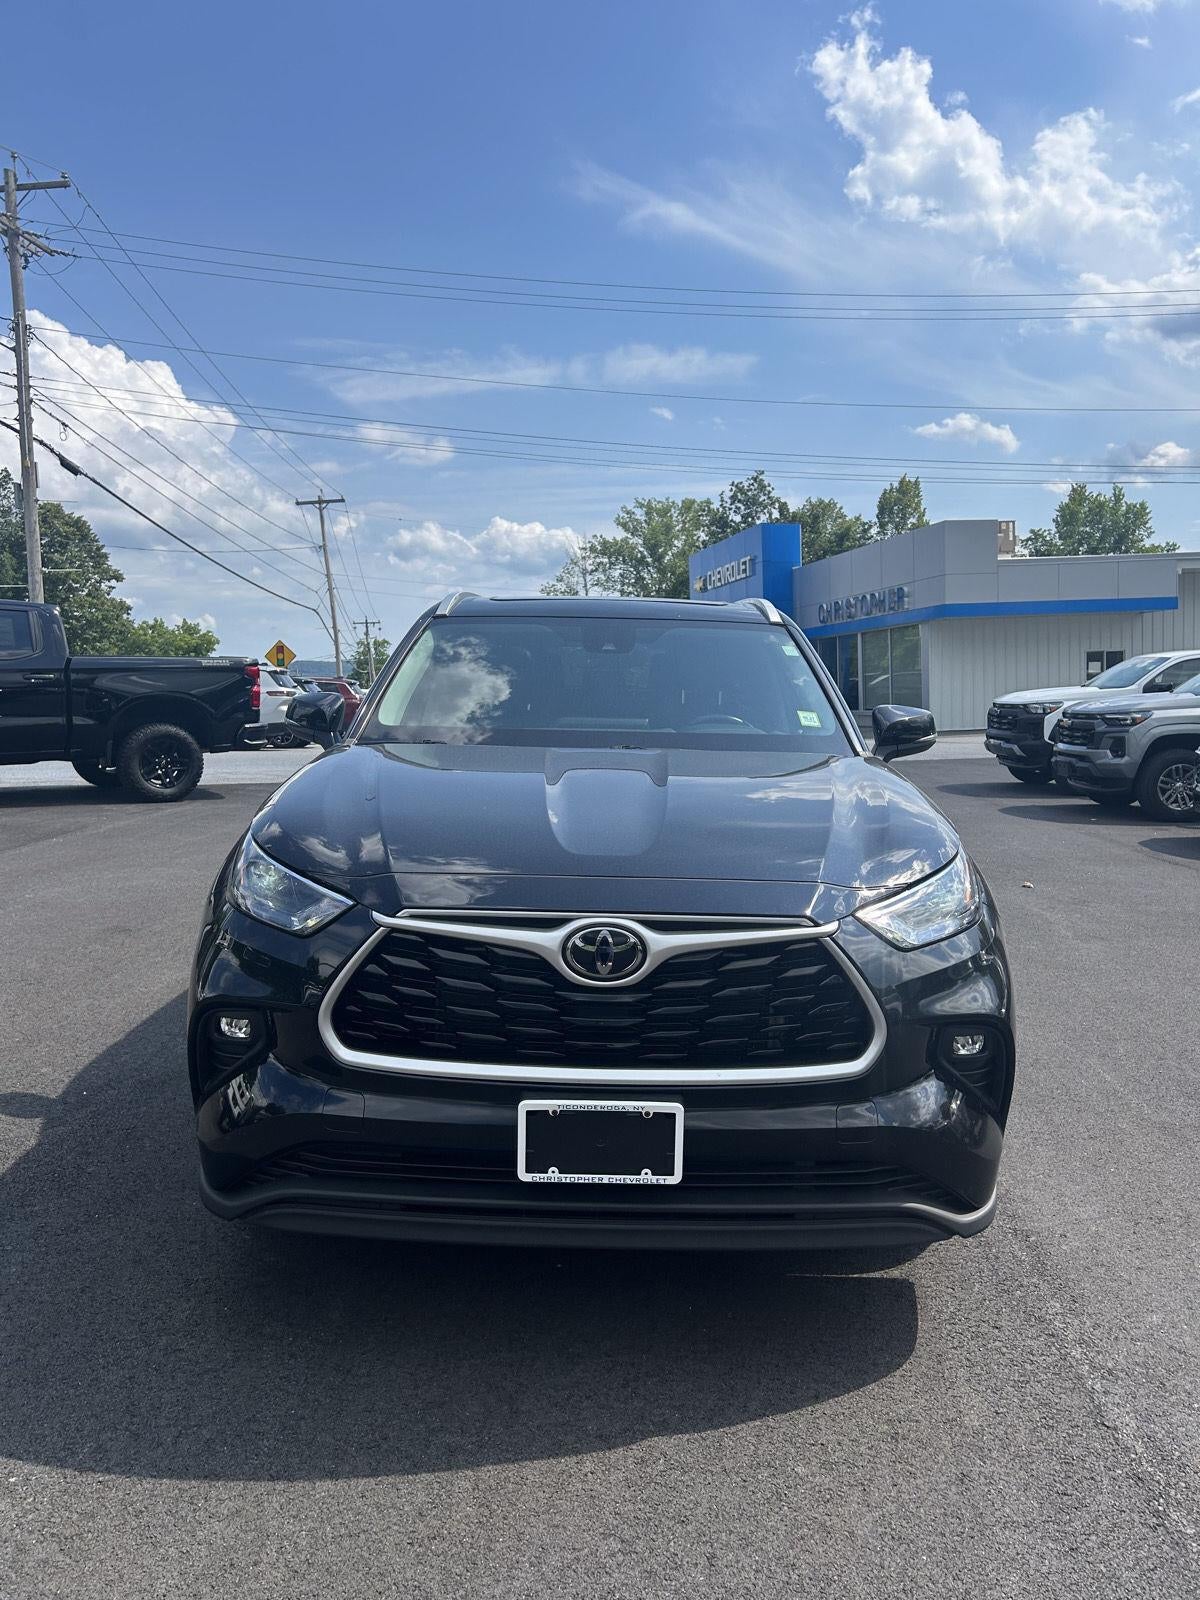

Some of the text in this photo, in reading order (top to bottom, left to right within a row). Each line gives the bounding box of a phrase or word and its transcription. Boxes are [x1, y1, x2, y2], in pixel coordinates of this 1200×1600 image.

[706, 555, 753, 590] CHEVROLET
[818, 586, 906, 624] CHRISTOPHER
[531, 1175, 604, 1183] CHRISTOPHER
